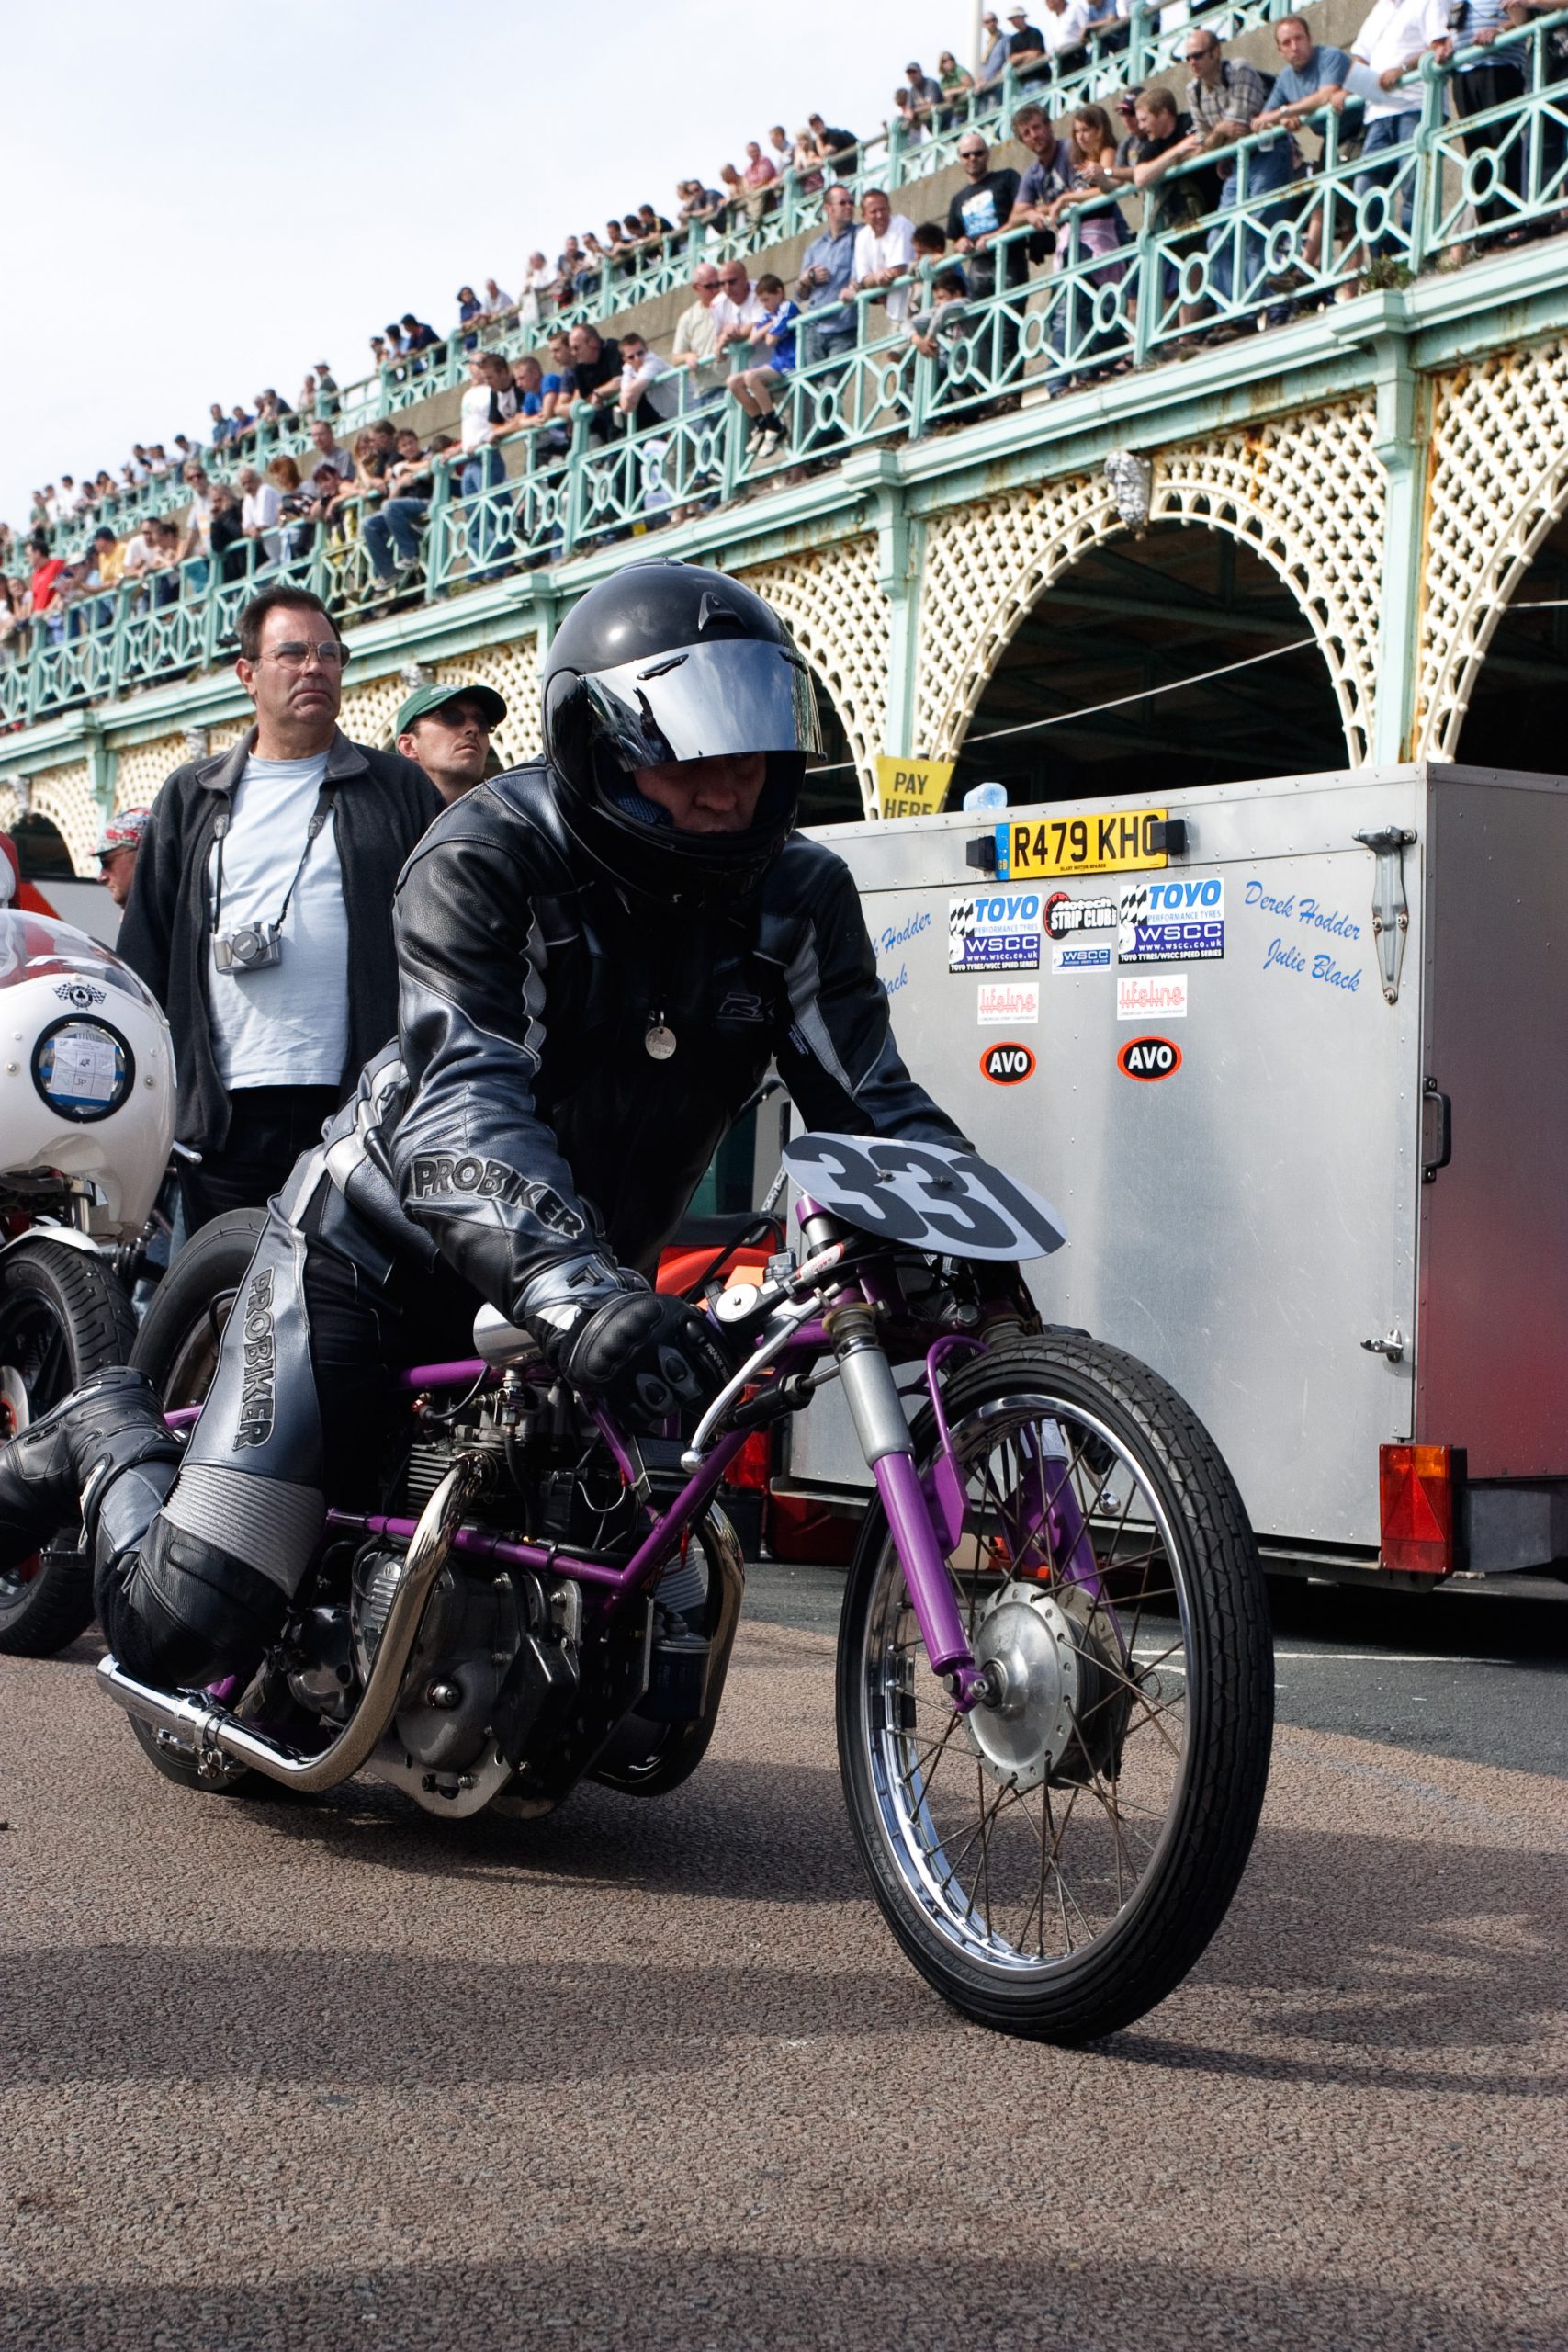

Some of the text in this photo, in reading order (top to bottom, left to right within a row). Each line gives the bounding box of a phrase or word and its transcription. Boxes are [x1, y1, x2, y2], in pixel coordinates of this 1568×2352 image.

[893, 771, 929, 796] PAY
[883, 798, 933, 819] HERE
[1014, 820, 1088, 867] R479
[1149, 879, 1222, 910] TOYO
[976, 895, 1039, 922] TOYO
[1050, 910, 1082, 930] STRIP
[1084, 908, 1111, 928] CLUB
[1147, 910, 1222, 922] PERFORMANCE TYRES
[1245, 880, 1360, 941] Derek Hodder
[881, 912, 931, 954] Hodder
[975, 923, 1038, 934] PERFORMANCE TYRES
[1138, 922, 1222, 942] WSCC
[966, 936, 1038, 953] WSCC
[967, 950, 1038, 961] www.wscc.co.uk
[1064, 950, 1109, 961] WSCC
[1120, 954, 1137, 962] TOYO
[1179, 949, 1200, 958] SPEED
[1201, 948, 1222, 957] SERIES
[1139, 939, 1222, 951] www.wscc.co.uk
[1002, 961, 1019, 969] SPEED
[1020, 959, 1038, 968] SERIES
[1263, 938, 1363, 992] Julie Black
[989, 1051, 1028, 1074] AVO
[1128, 1046, 1172, 1070] AVO
[412, 1156, 585, 1239] PROBIKER
[783, 1136, 1066, 1254] 331
[232, 1267, 275, 1451] PROBIKER
